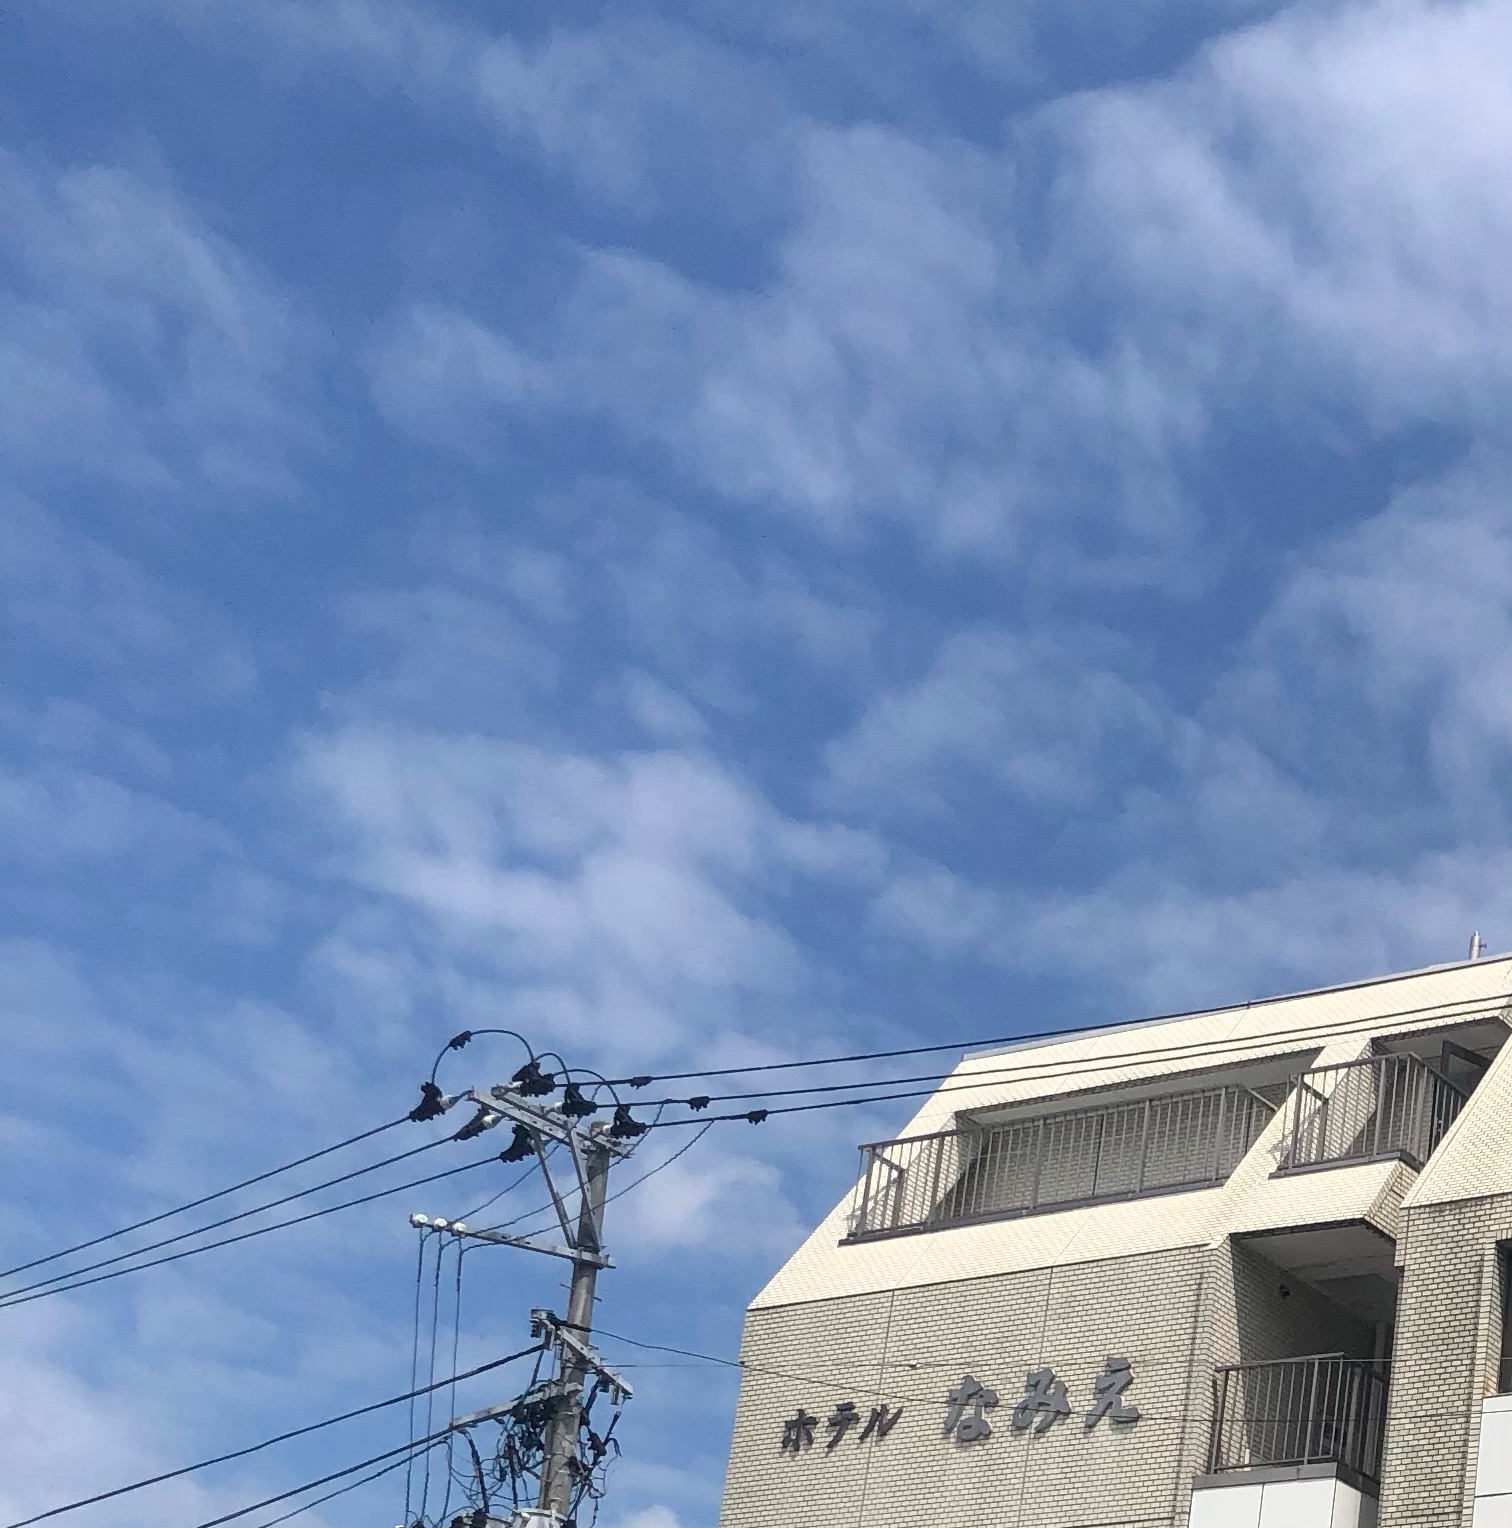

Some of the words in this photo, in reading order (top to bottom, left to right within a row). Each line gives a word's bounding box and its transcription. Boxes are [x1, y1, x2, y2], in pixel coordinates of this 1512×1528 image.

[781, 1402, 902, 1452] ホテル
[944, 1357, 1142, 1442] なみえ
